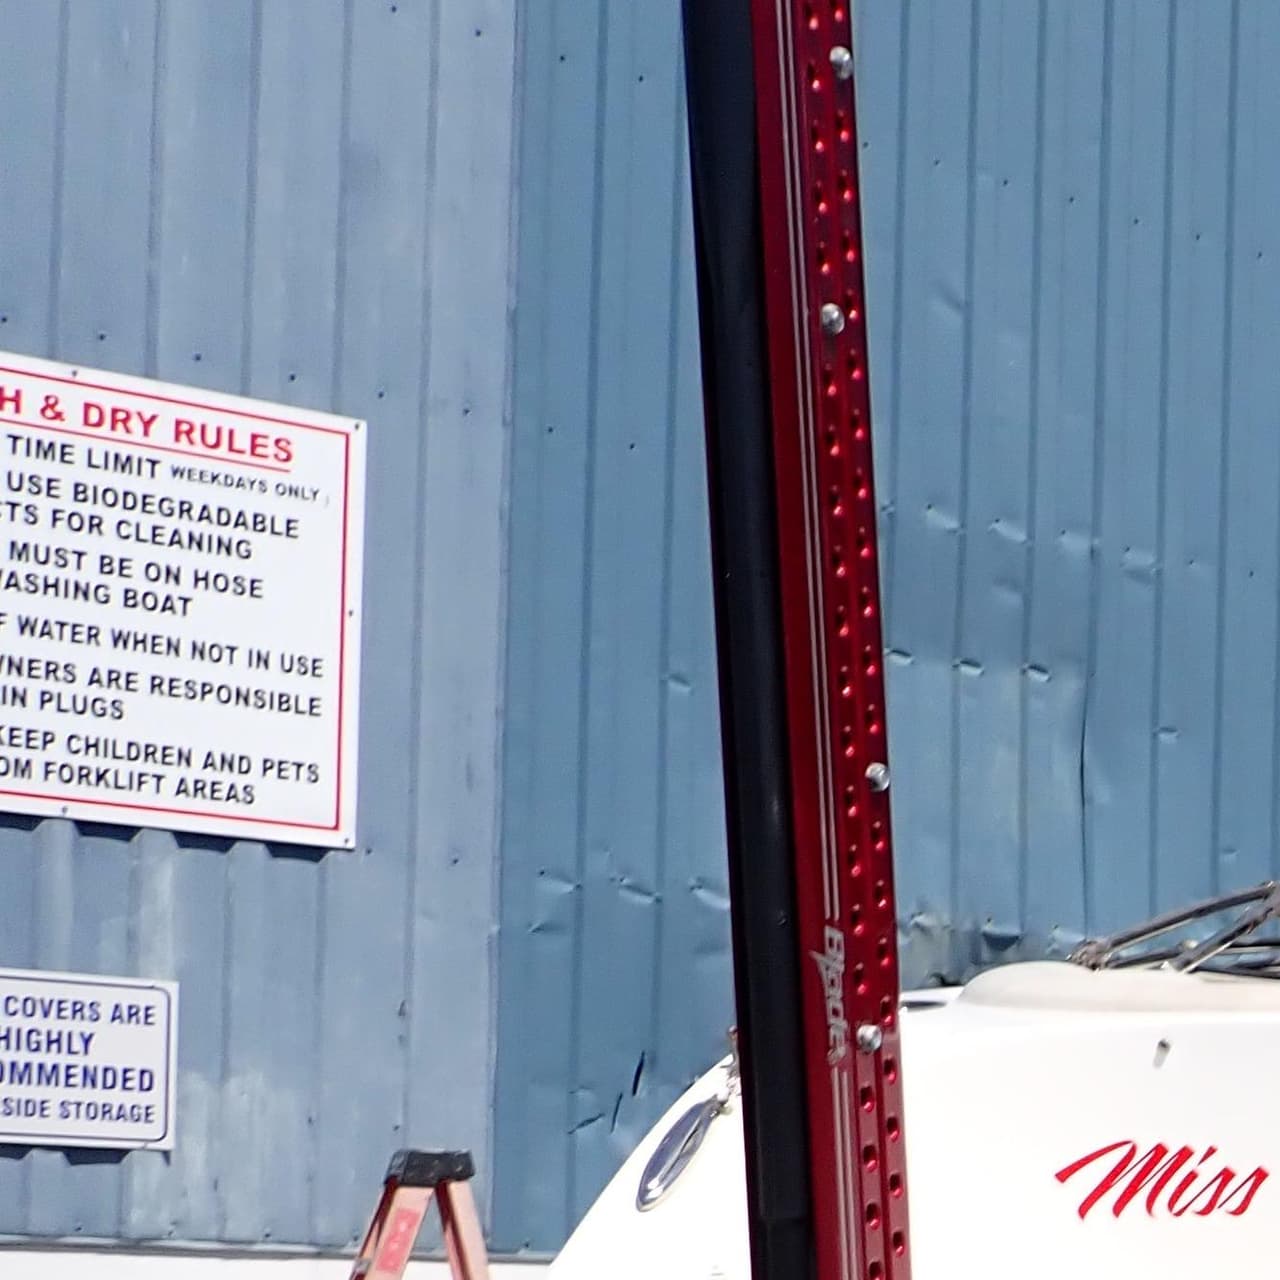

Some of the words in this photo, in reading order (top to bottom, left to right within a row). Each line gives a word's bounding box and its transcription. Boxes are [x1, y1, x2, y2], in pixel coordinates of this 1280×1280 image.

[0, 386, 21, 415] H
[40, 395, 65, 422] &
[83, 402, 159, 438] DRY
[174, 417, 293, 464] RULES
[7, 434, 76, 465] TIME
[87, 448, 161, 479] LIMIT
[171, 465, 268, 494] WEEKDAYS
[7, 470, 61, 499] USE
[73, 482, 300, 539] BIODEGRADABLE
[0, 501, 39, 526] TS
[51, 508, 104, 536] FOR
[116, 519, 253, 561] CLEANING
[0, 568, 111, 605] ASHING
[123, 588, 193, 618] BOAT
[9, 540, 88, 571] MUST
[99, 555, 133, 579] BE
[145, 562, 182, 587] ON
[193, 570, 264, 599] HOSE
[17, 614, 101, 648] WATER
[111, 628, 182, 658] WHEN
[191, 640, 239, 666] NOT
[247, 648, 271, 670] IN
[280, 654, 324, 679] USE
[2, 685, 28, 709] IN
[39, 690, 125, 720] PLUGS
[88, 668, 139, 692] ARE
[150, 675, 322, 717] RESPONSIBLE
[43, 761, 167, 798] FORKLIFT
[175, 776, 256, 806] AREAS
[67, 733, 193, 768] CHILDREN
[202, 751, 252, 775] AND
[262, 758, 321, 784] PETS
[4, 996, 102, 1023] COVERS
[110, 1003, 157, 1026] ARE
[0, 1026, 95, 1056] HIGHLY
[3, 1097, 51, 1119] SIDE
[59, 1100, 156, 1124] STORAGE
[1054, 1139, 1270, 1221] Miss
